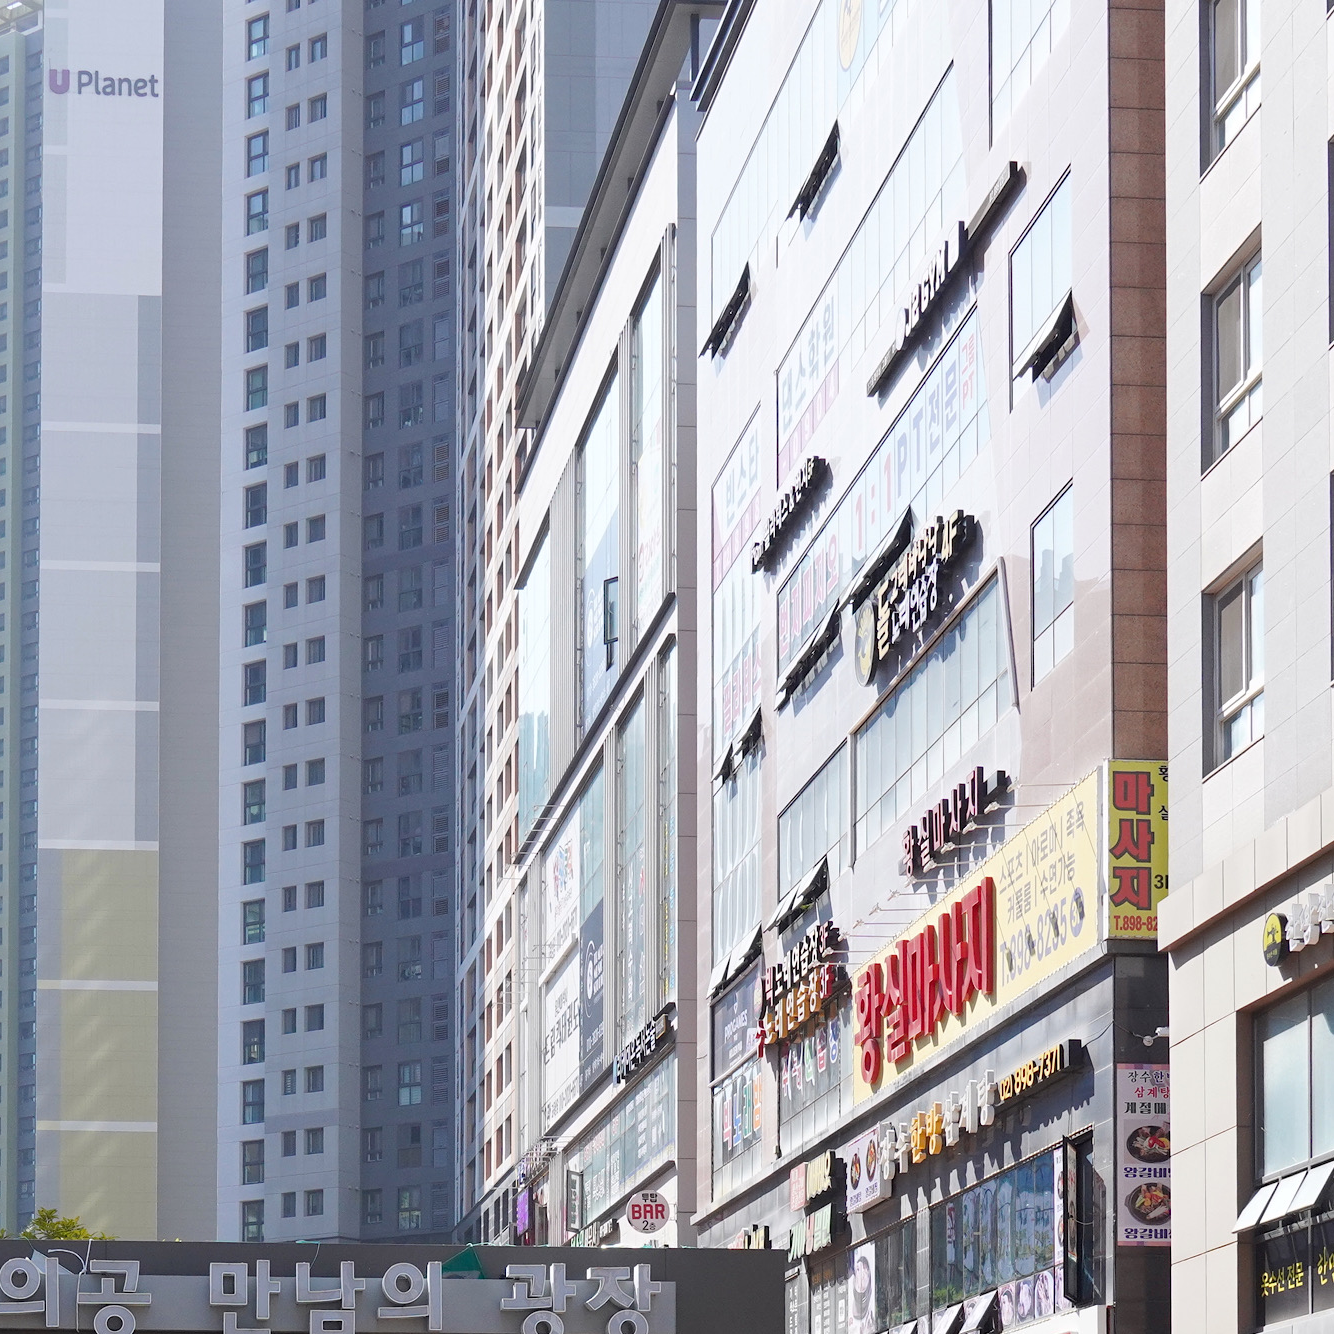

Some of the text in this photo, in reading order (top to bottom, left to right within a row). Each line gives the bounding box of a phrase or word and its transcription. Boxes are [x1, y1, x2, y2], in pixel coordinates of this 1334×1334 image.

[77, 70, 159, 97] Planet
[781, 296, 835, 437] 댄스학원
[902, 767, 983, 876] 황실마사지
[999, 801, 1084, 894] 스포츠 아로마 족욕
[1109, 770, 1154, 910] 마사지
[1007, 851, 1075, 924] 커플룸 수면가능
[819, 926, 829, 954] 3F
[820, 968, 830, 1000] 3F
[854, 877, 993, 1084] 황실마사지
[880, 1070, 995, 1180] 장수한방삼계탕
[1000, 1081, 1013, 1101] 02)
[1014, 1046, 1061, 1095] 898-7371
[631, 1203, 665, 1220] BAR
[642, 1220, 656, 1231] 2층
[1261, 1263, 1304, 1297] 옷수선 전문
